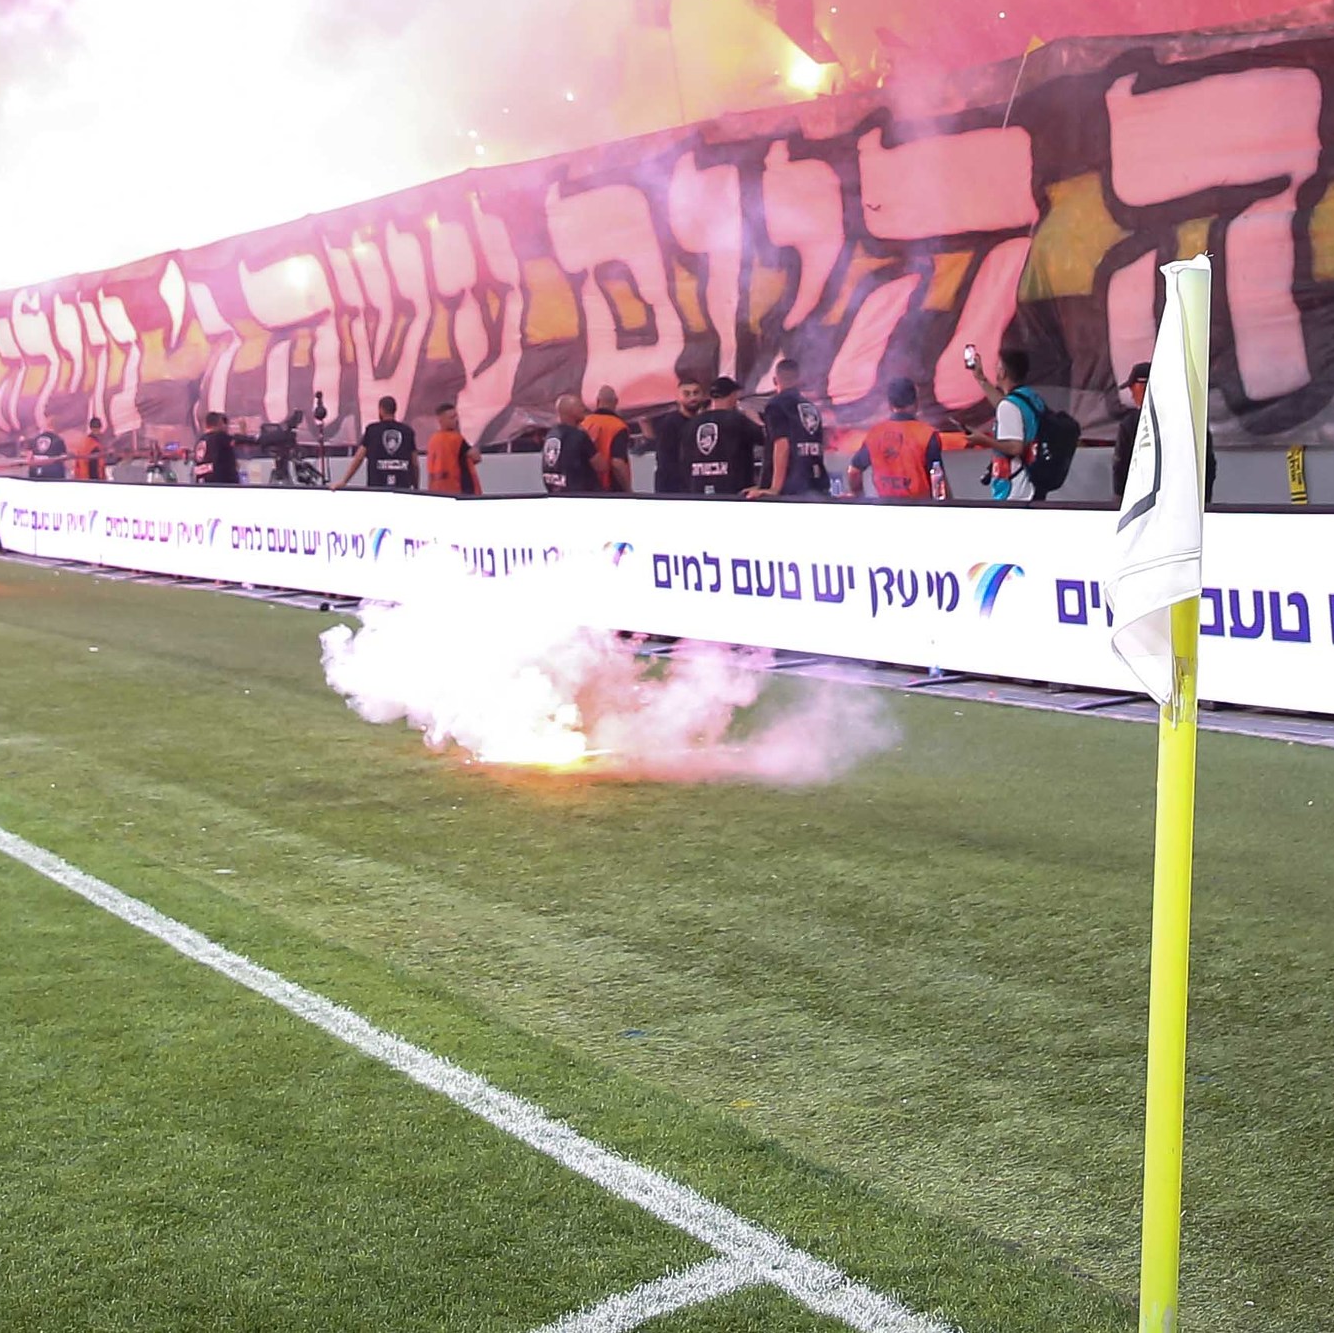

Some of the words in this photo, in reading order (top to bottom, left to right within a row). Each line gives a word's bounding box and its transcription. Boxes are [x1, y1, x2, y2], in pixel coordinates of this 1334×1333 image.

[231, 523, 262, 550] למים
[267, 527, 298, 554] טעם
[303, 529, 321, 555] יש
[652, 551, 722, 593] למים
[731, 558, 803, 601] טעם
[811, 563, 856, 604] יש
[868, 566, 918, 618] עדן
[925, 569, 960, 613] מי
[1055, 578, 1114, 628] ים
[1200, 587, 1312, 644] טעם
